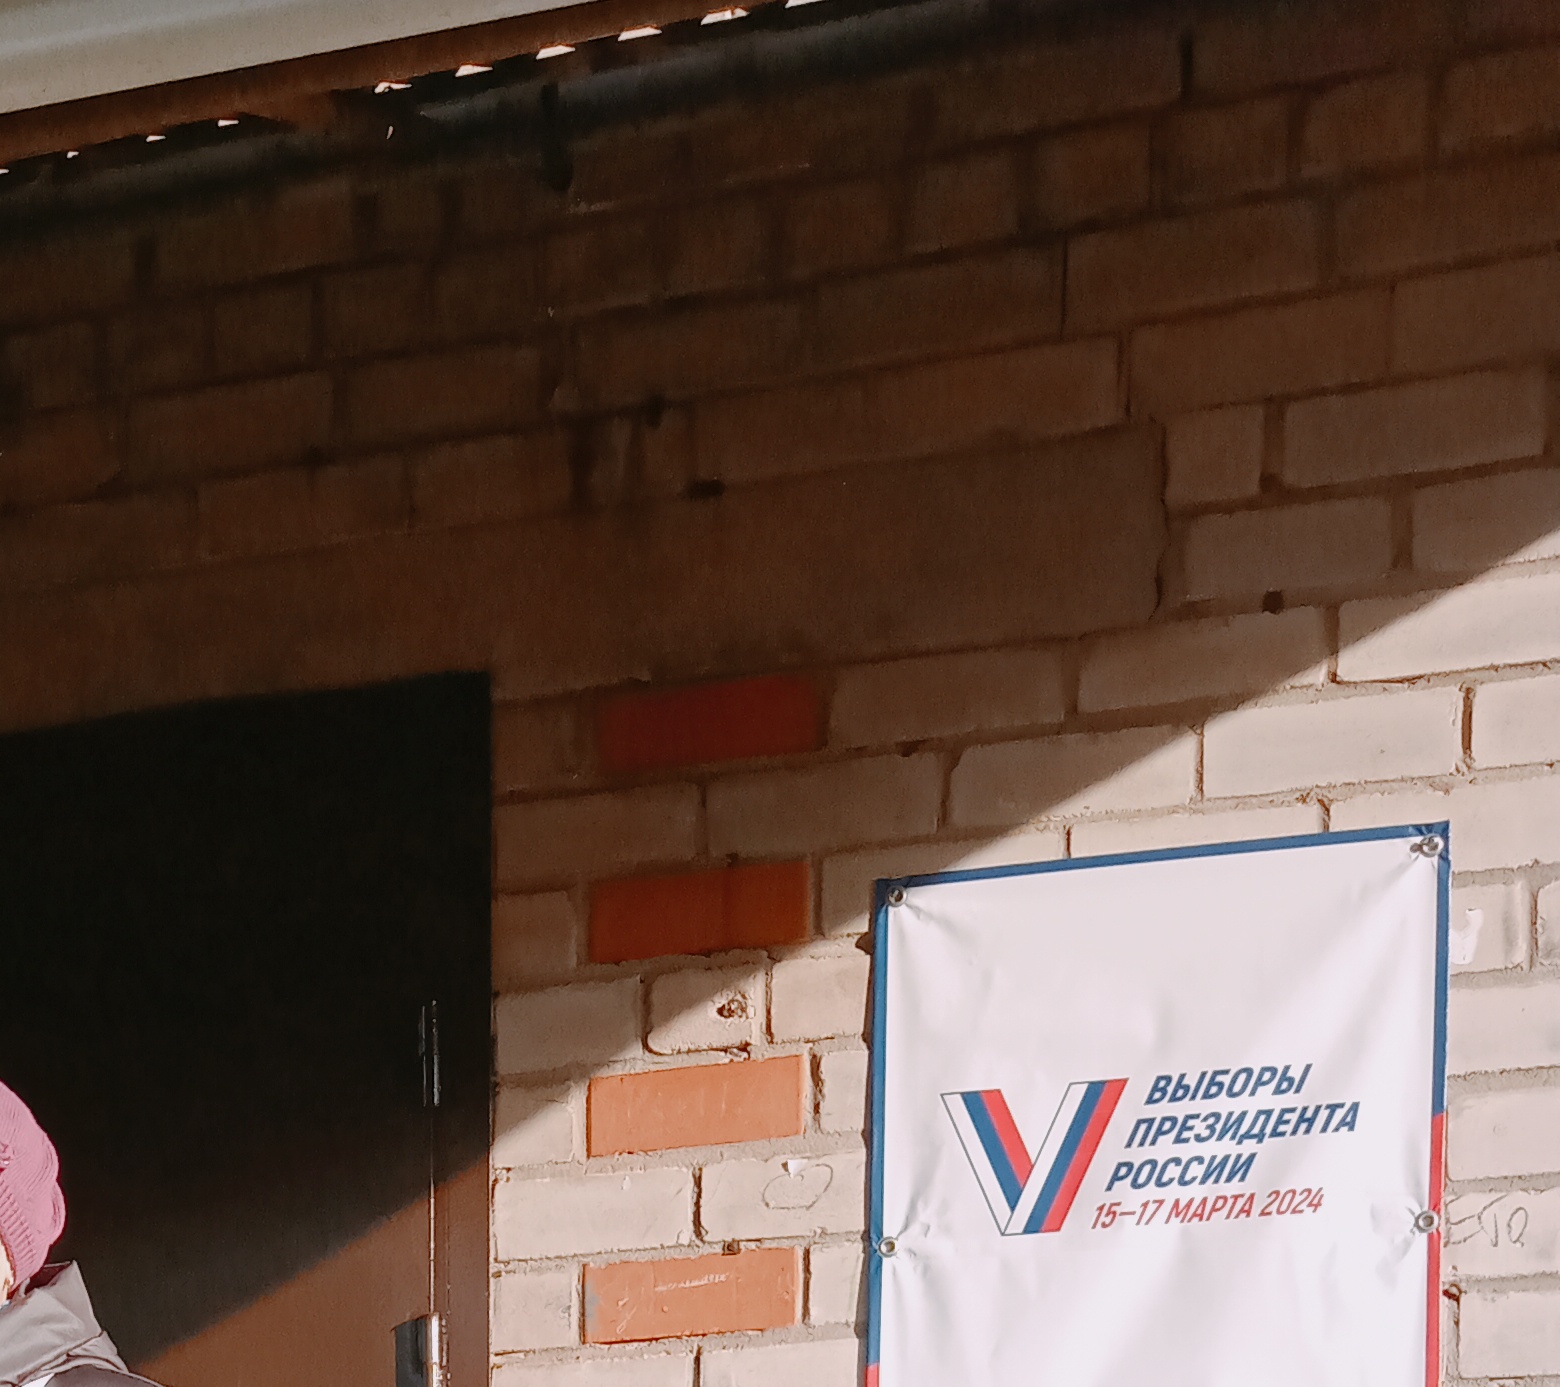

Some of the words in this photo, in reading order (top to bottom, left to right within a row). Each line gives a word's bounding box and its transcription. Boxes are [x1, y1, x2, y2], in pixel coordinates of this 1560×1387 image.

[1143, 1063, 1313, 1106] ВЫБОРЫ
[1124, 1101, 1361, 1149] ПРЕЗИДЕНТА
[1104, 1152, 1258, 1192] РОССИИ
[1164, 1193, 1254, 1225] МАРТА
[1257, 1187, 1325, 1218] 2024
